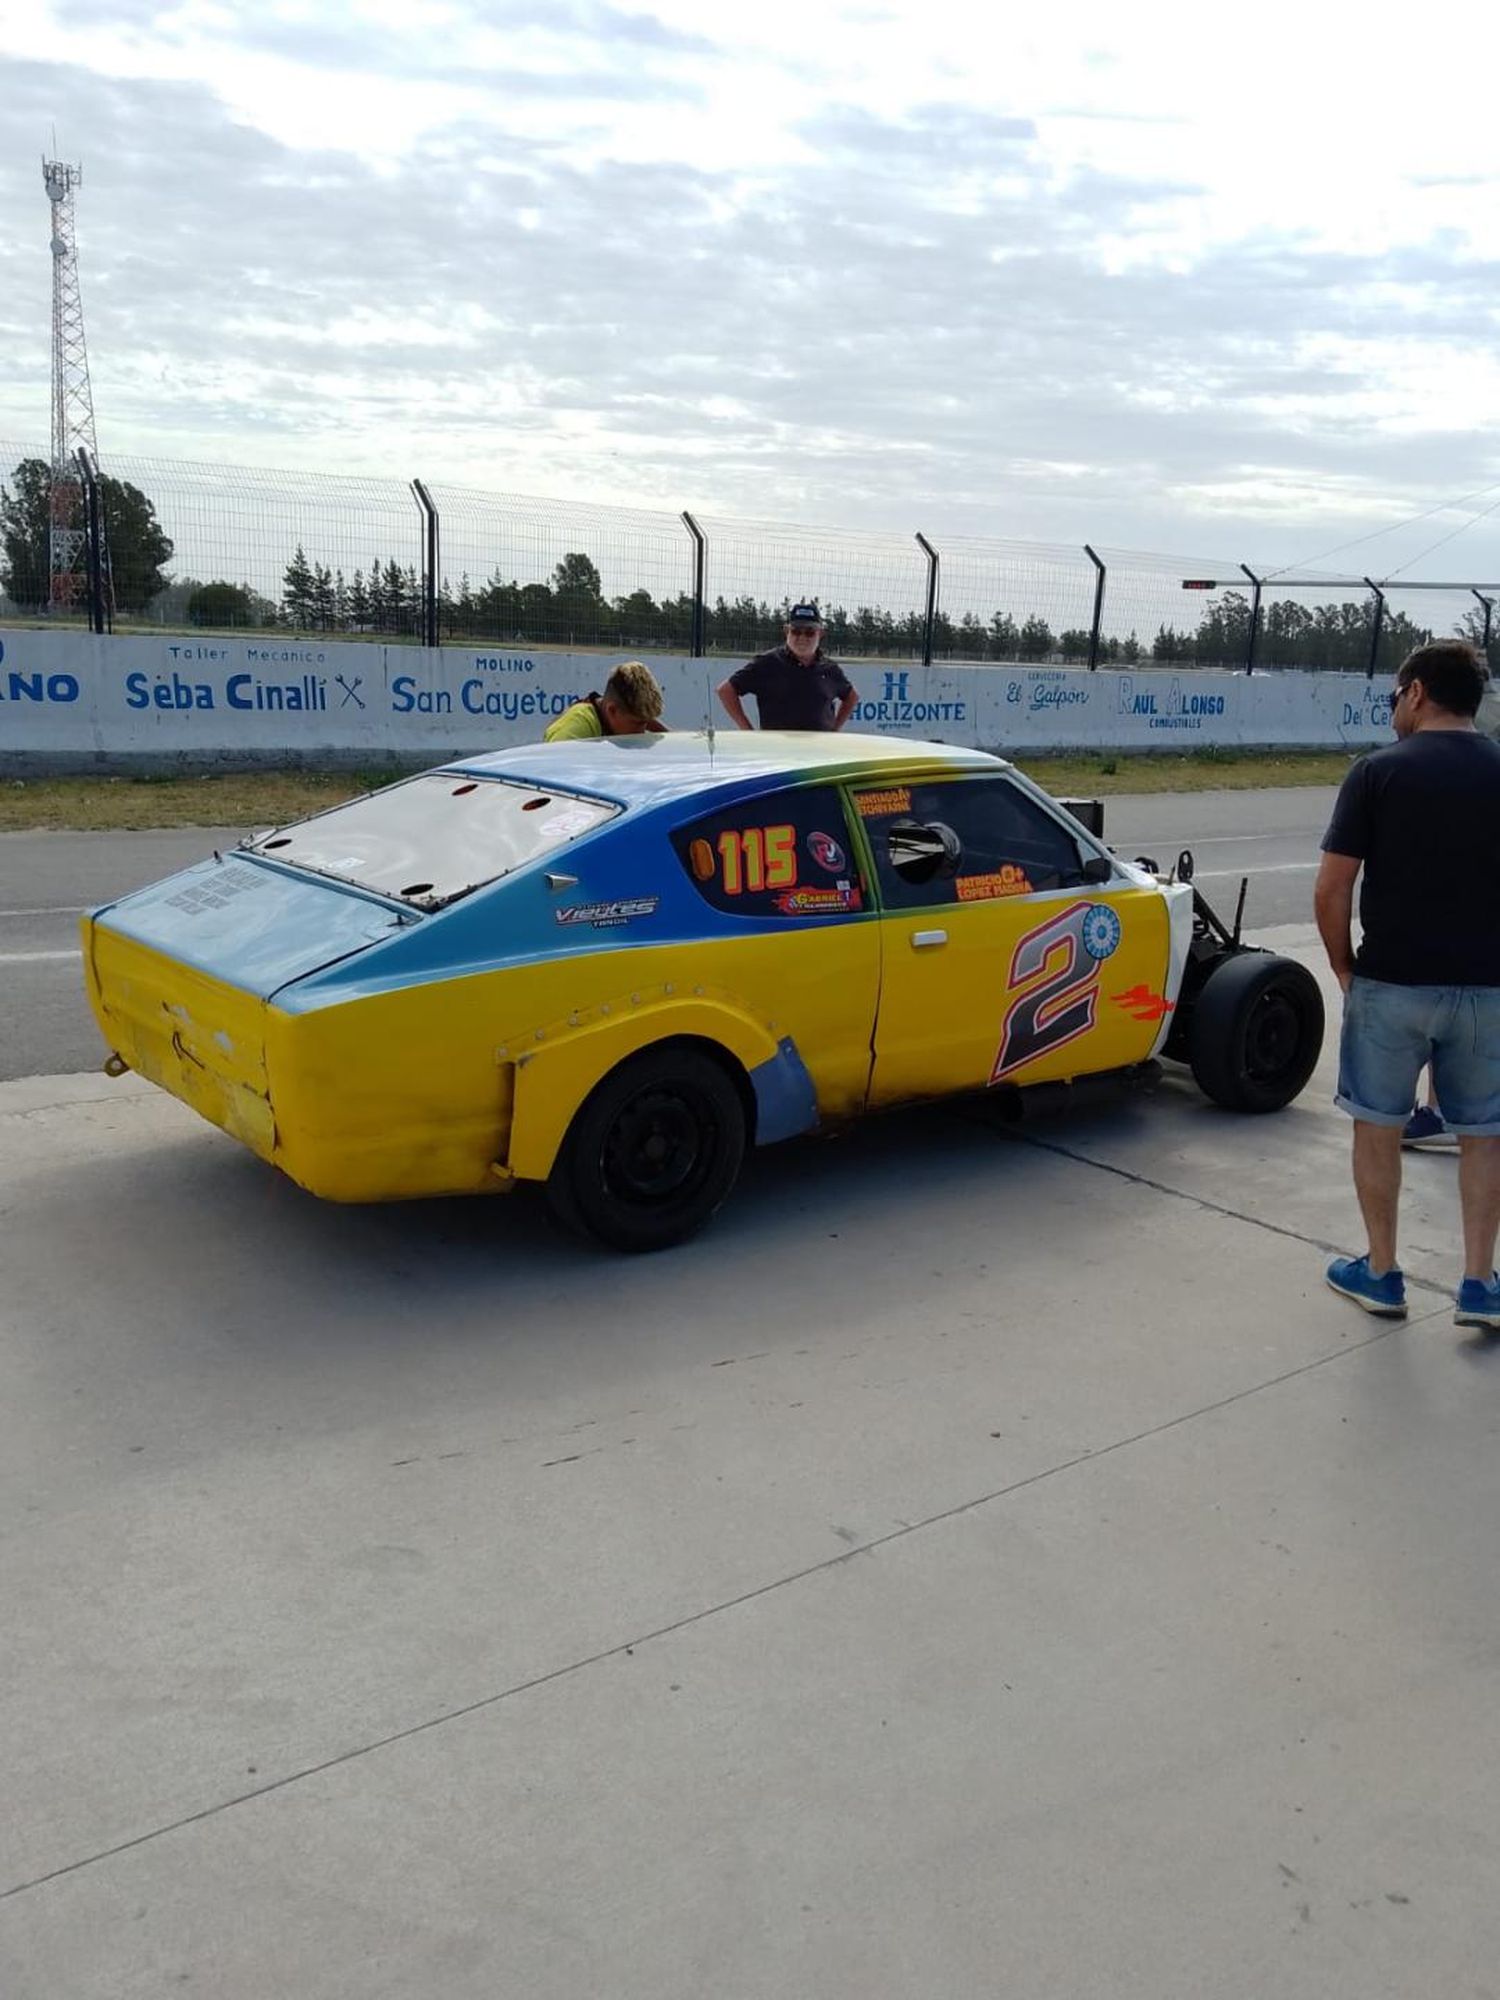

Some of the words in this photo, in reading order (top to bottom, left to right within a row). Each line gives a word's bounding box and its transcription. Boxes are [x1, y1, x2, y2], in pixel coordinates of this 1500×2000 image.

[168, 646, 228, 660] Taller
[476, 657, 536, 672] MOLINO
[0, 671, 79, 702] NO
[126, 672, 215, 710] Seba
[226, 673, 327, 711] Cinalli
[392, 676, 452, 713] San
[850, 702, 966, 721] HORIZONTE
[1343, 703, 1363, 726] Del
[717, 825, 798, 895] 115
[987, 901, 1104, 1086] 2
